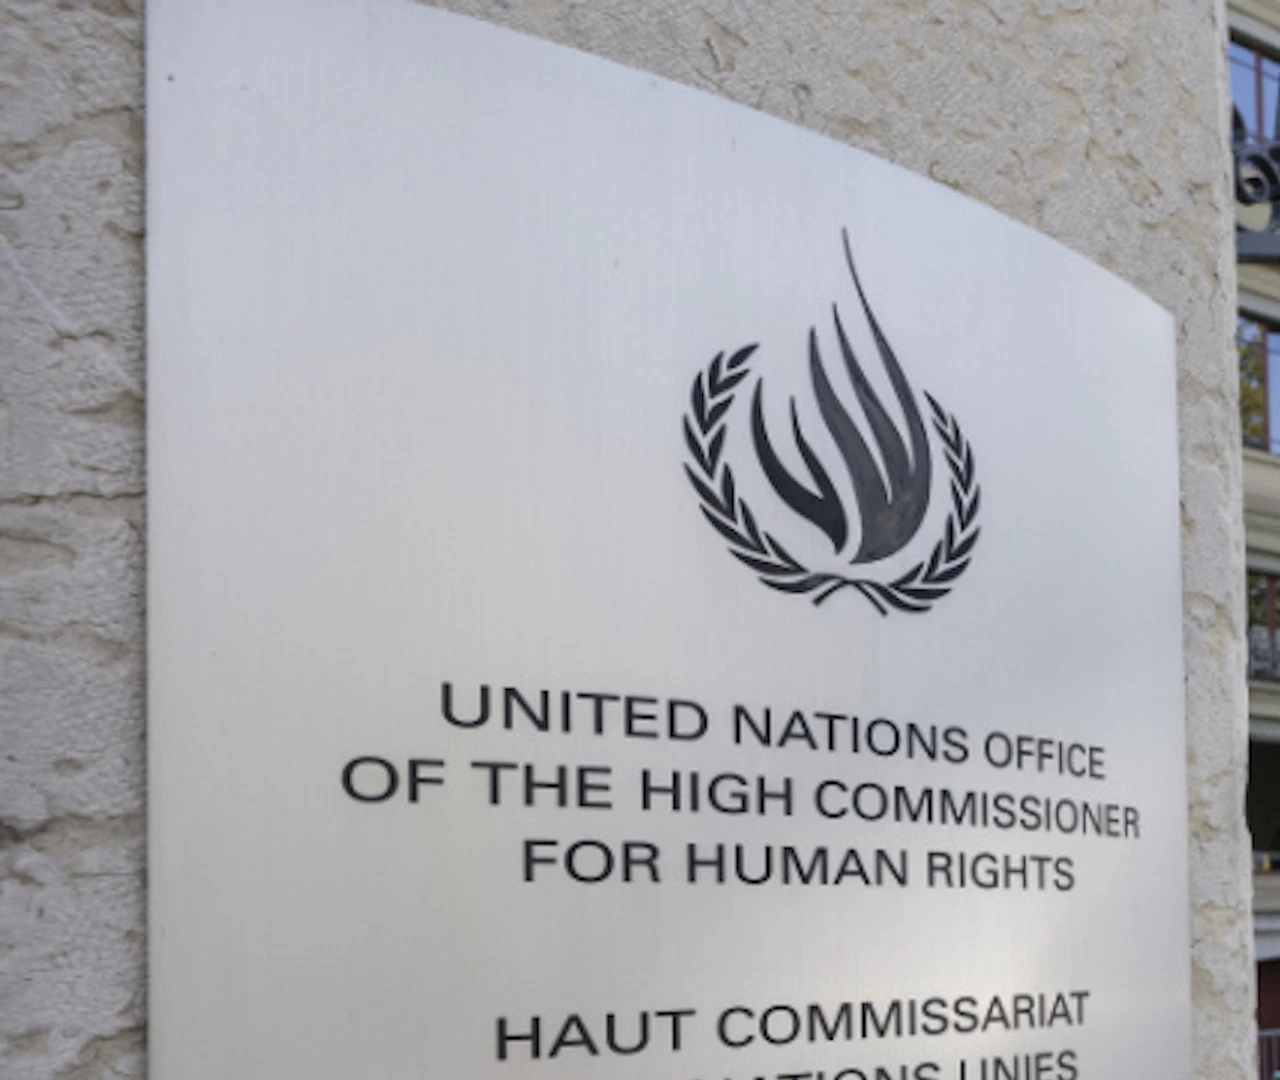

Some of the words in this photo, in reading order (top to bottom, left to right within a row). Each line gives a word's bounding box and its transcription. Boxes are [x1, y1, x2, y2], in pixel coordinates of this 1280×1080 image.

[441, 682, 709, 742] UNITED
[733, 704, 969, 765] NATIONS
[984, 731, 1105, 780] OFFICE
[341, 756, 445, 804] OF
[470, 761, 612, 810] THE
[641, 768, 793, 816] HIGH
[814, 779, 1140, 839] COMMISSIONER
[523, 839, 661, 884] FOR
[687, 843, 908, 887] HUMAN
[927, 851, 1075, 892] RIGHTS
[496, 1008, 696, 1061] HAUT
[716, 990, 1090, 1049] COMMISSARIAT
